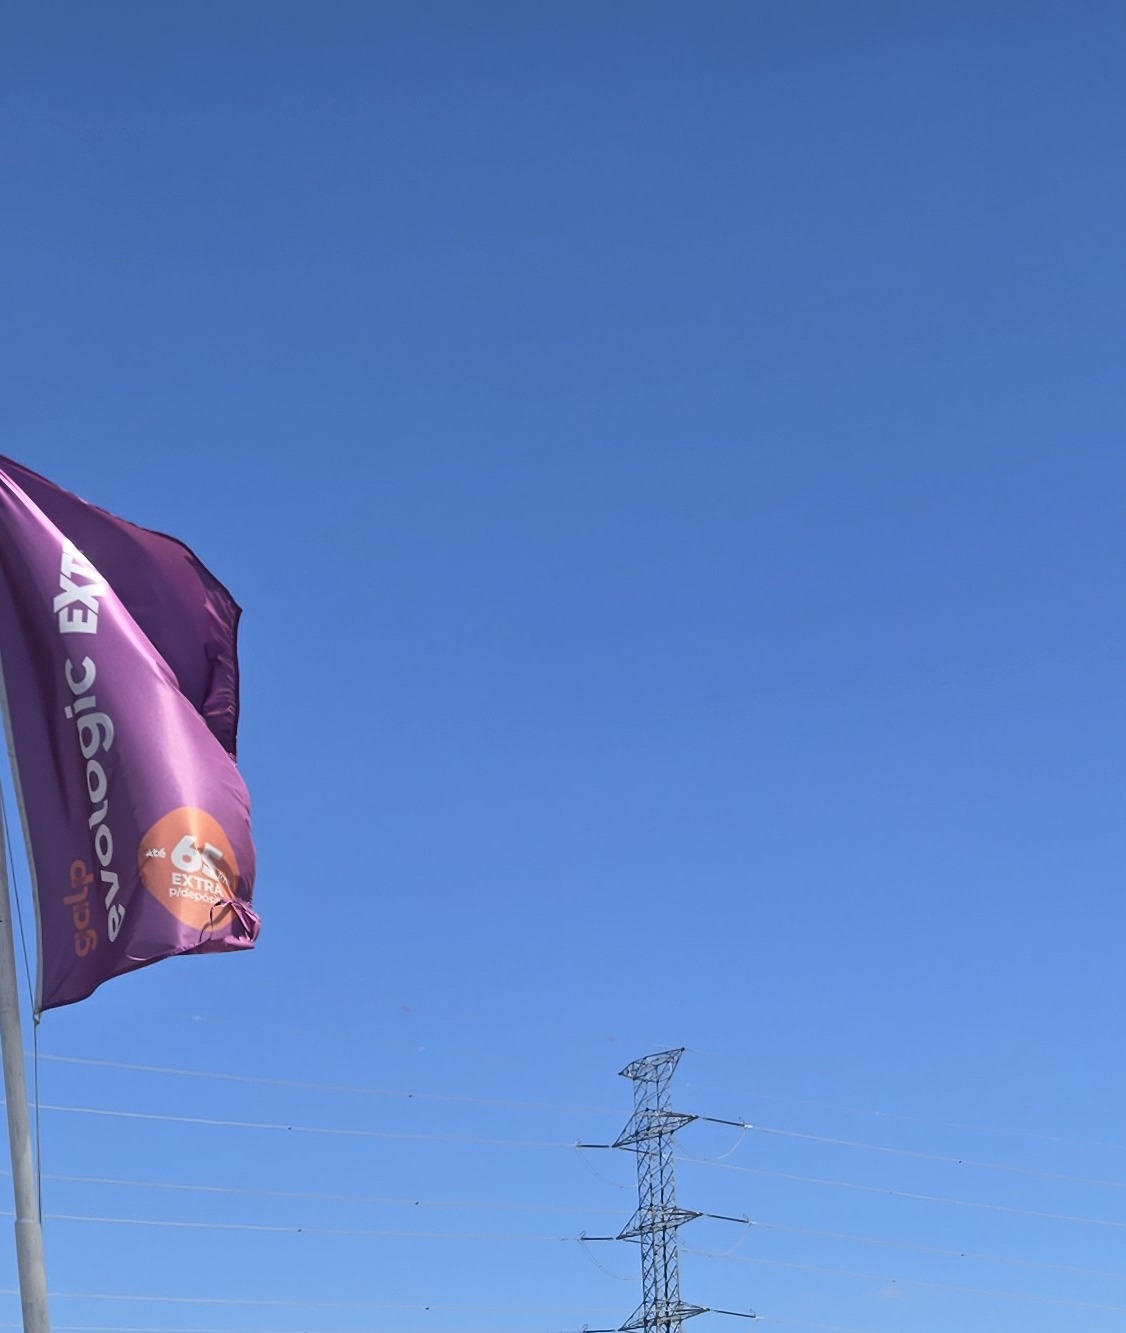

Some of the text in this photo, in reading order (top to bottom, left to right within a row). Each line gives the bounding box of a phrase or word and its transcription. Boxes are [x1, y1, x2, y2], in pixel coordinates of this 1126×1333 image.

[53, 539, 127, 944] evologic EXT
[62, 859, 98, 960] galp
[171, 872, 223, 897] EXTRA
